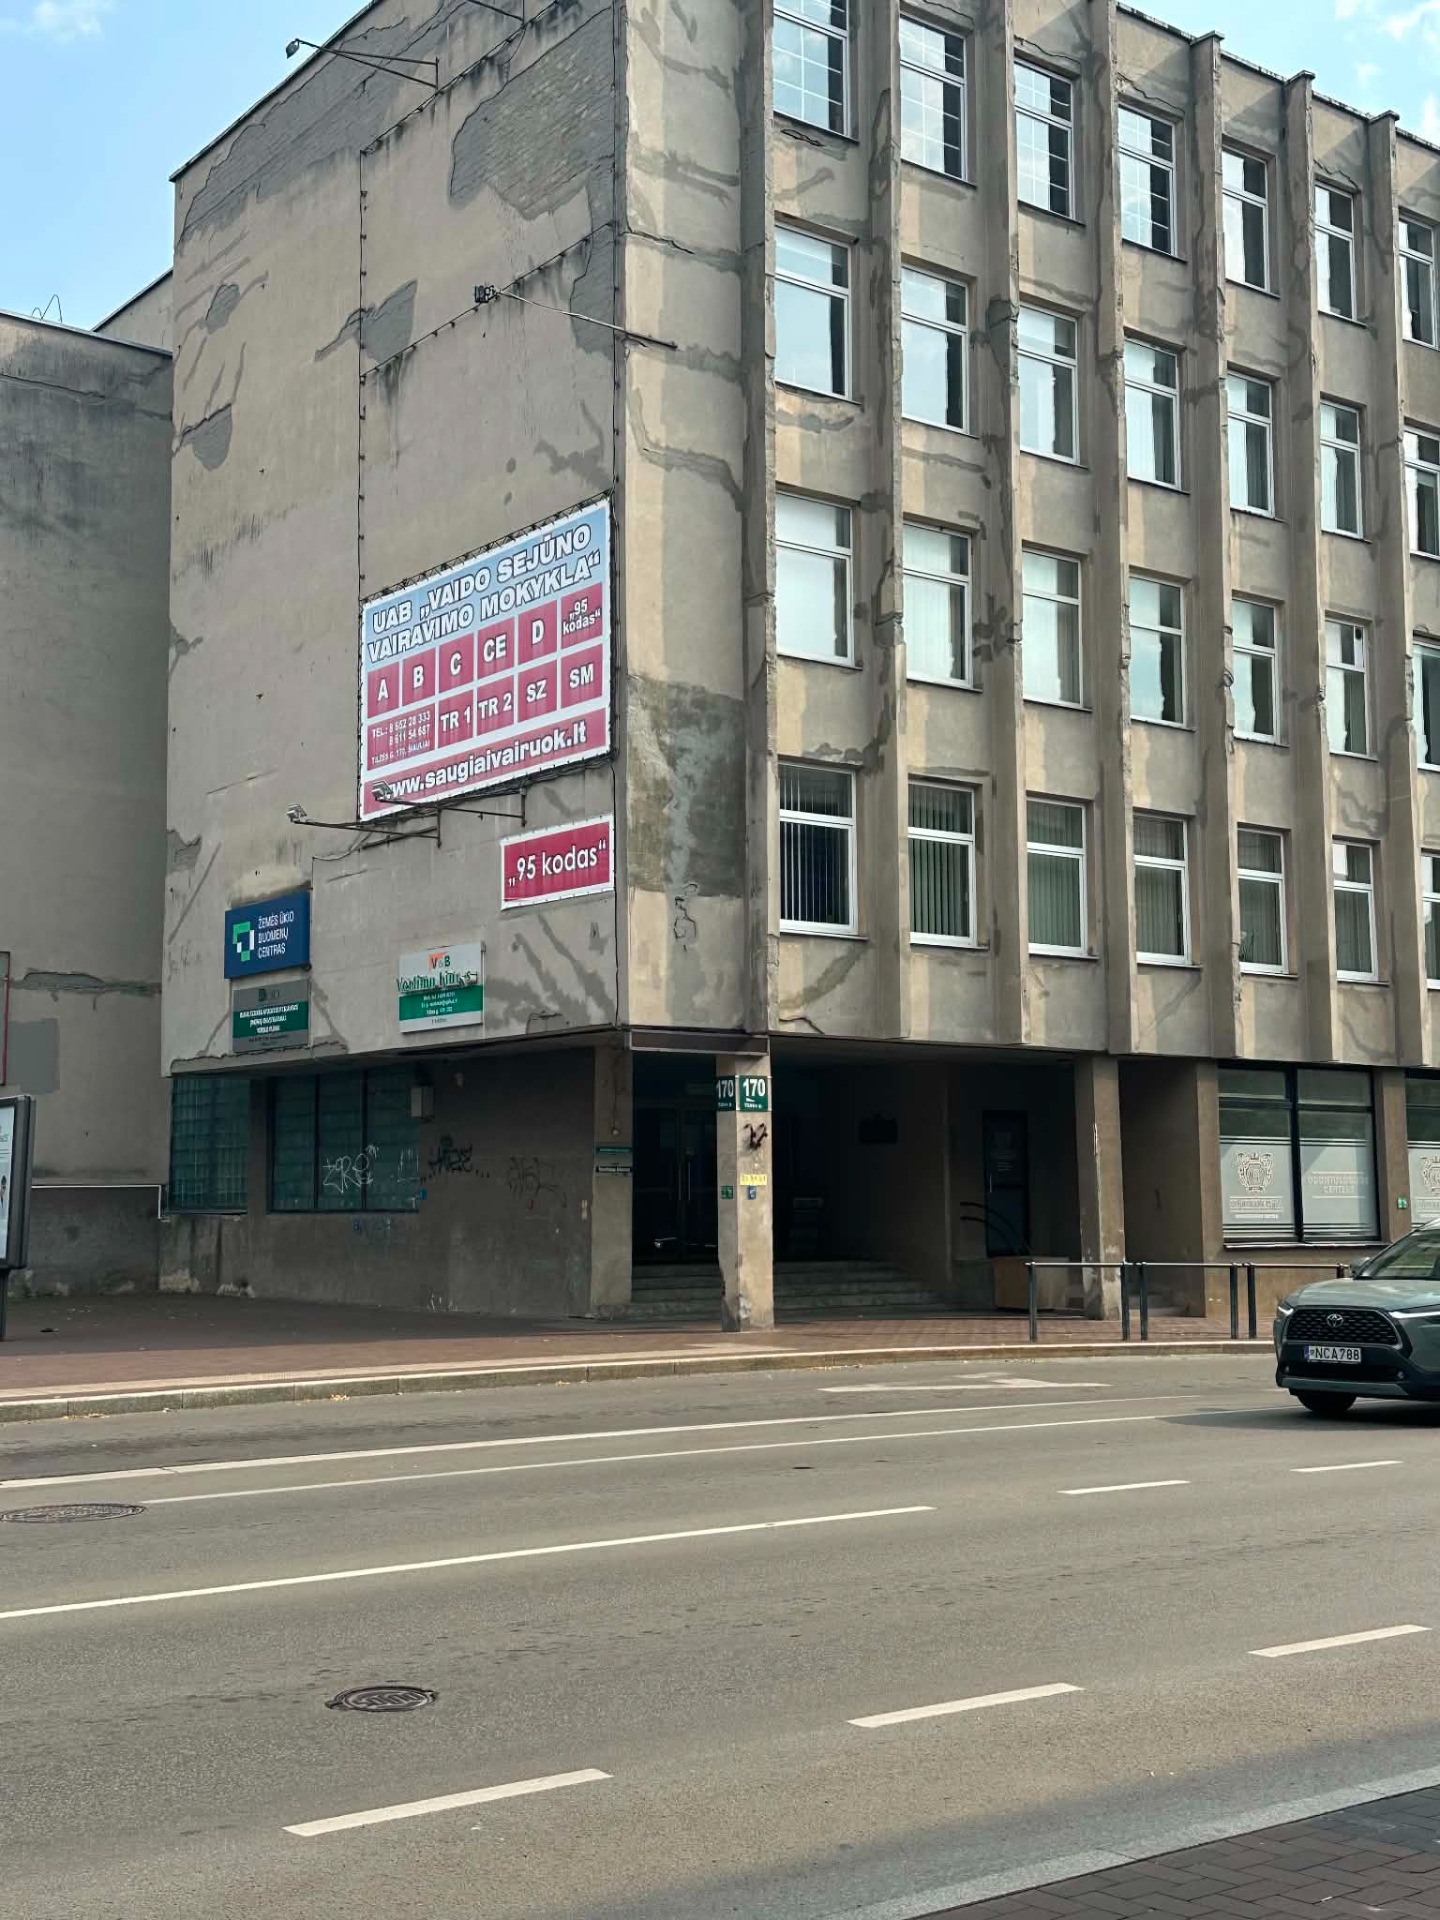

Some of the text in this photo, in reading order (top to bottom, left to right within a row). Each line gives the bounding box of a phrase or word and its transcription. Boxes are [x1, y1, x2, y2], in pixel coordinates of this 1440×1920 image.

[367, 549, 601, 663] VAIRAVIMO MOKYKLA“
[372, 600, 413, 633] UAB
[420, 567, 491, 619] „VAIDO
[531, 619, 545, 645] D
[562, 607, 602, 635] kodas“
[483, 634, 507, 662] CE
[412, 665, 424, 688] B
[450, 652, 462, 676] C
[569, 663, 594, 689] SM
[377, 678, 389, 701] A
[526, 679, 547, 703] SZ
[478, 692, 512, 719] TR 2
[440, 706, 472, 732] TR 1
[379, 719, 587, 799] ww.saugiaivairuok.lt
[508, 839, 606, 887] „95 kodas“
[258, 910, 295, 929] ŽEMĖS ŪKIO
[258, 927, 289, 944] DUOMENŲ
[258, 943, 286, 959] CENTRAS
[716, 1079, 734, 1098] 170
[743, 1078, 766, 1097] 170
